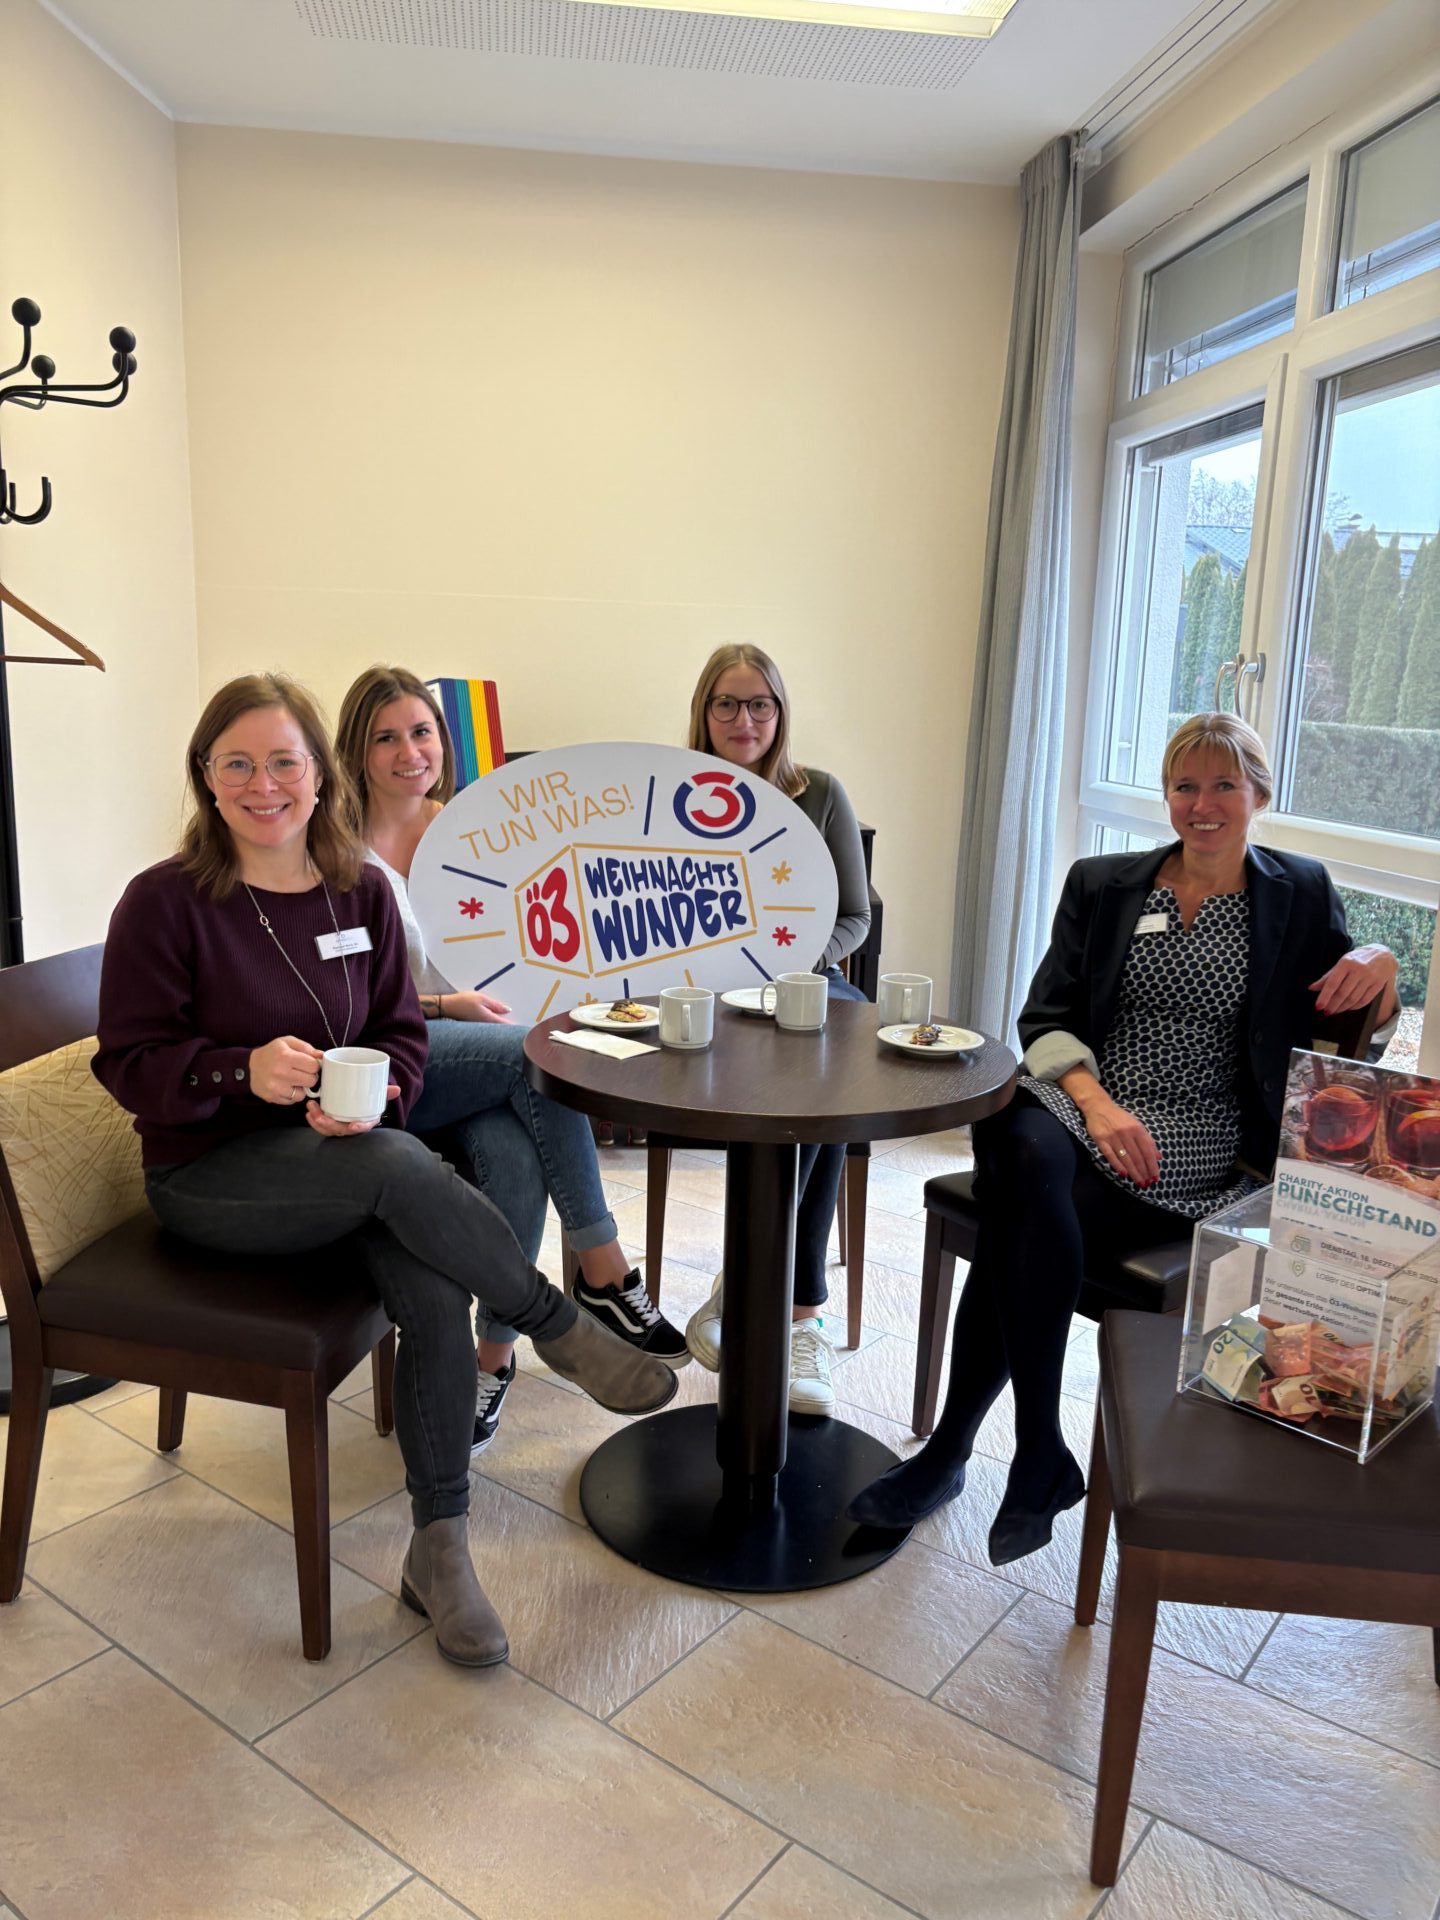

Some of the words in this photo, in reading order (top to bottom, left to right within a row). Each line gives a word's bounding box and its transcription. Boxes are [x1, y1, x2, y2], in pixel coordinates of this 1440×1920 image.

[499, 770, 577, 814] WIR
[459, 820, 538, 860] TUN
[541, 783, 635, 834] WAS!
[585, 856, 739, 898] WEIHNACHTS
[525, 867, 581, 963] Ö3
[592, 889, 748, 962] WUNDER
[1277, 1181, 1437, 1237] PUNSCHSTAND
[1278, 1172, 1369, 1203] CHARITY-AKTION
